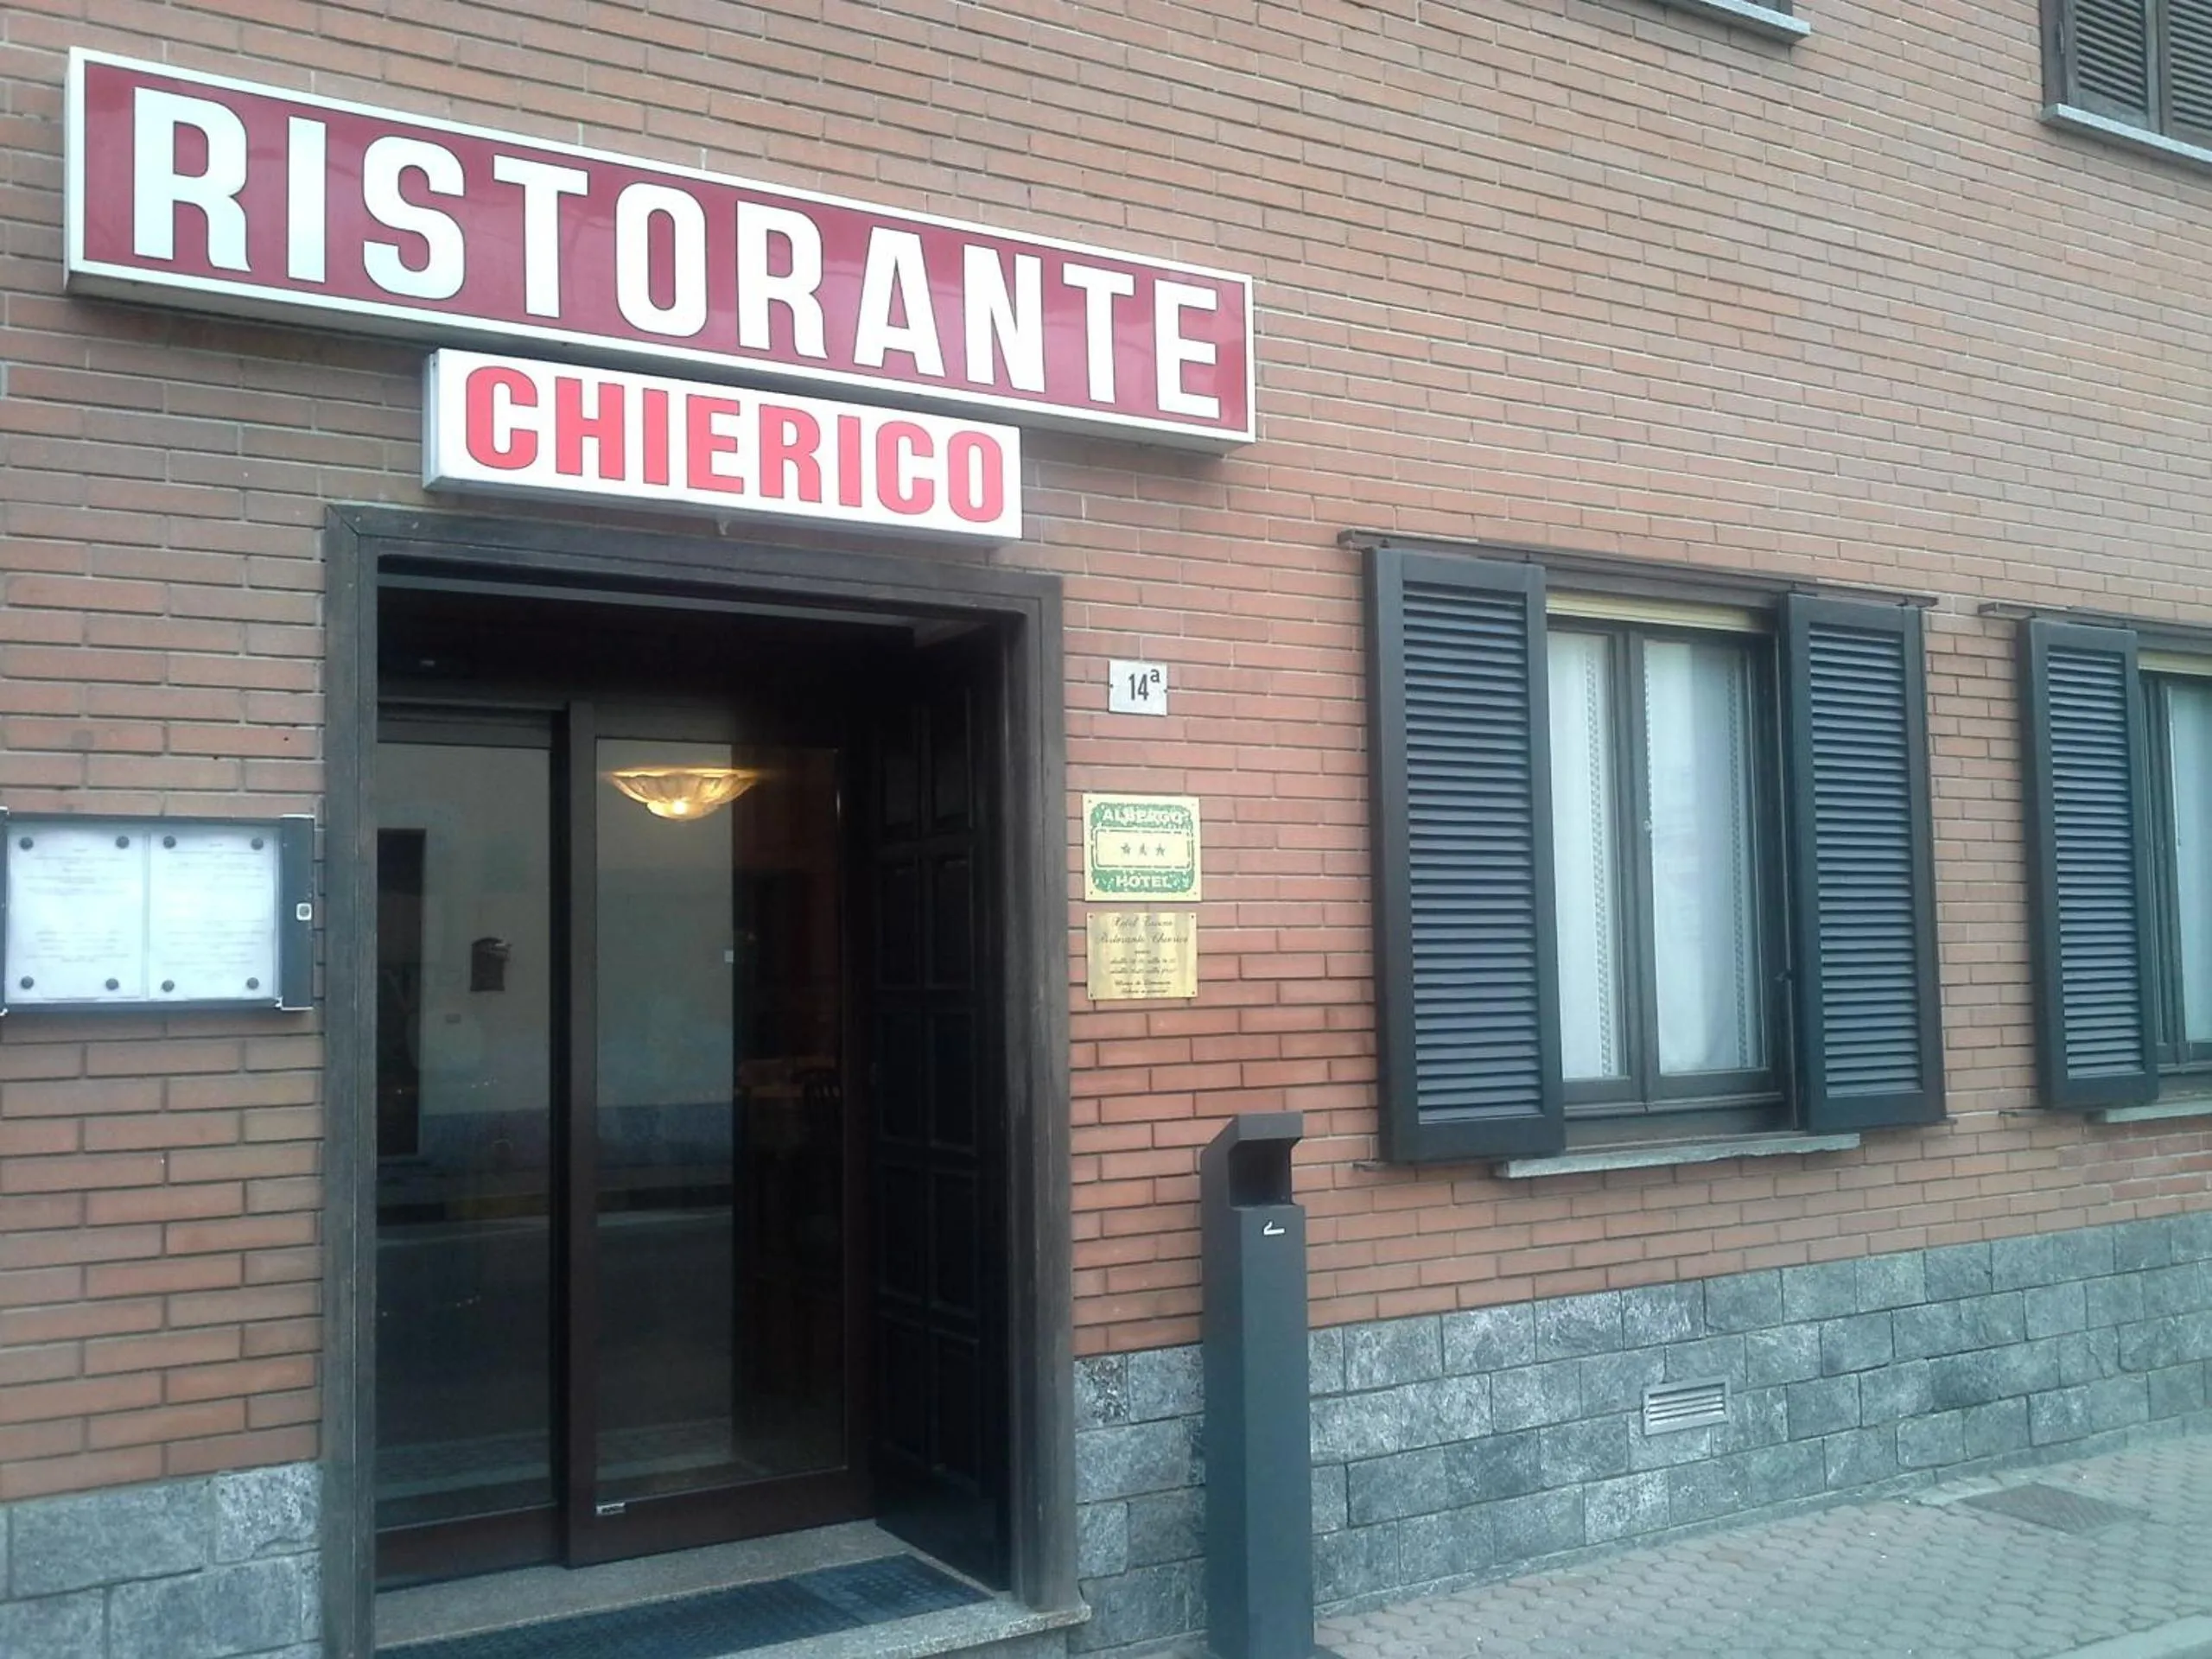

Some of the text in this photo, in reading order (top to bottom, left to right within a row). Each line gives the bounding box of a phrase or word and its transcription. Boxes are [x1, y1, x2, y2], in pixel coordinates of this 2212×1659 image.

[131, 86, 1220, 418] RISTORANTE
[464, 365, 1006, 524] CHIERICO
[1102, 806, 1184, 825] ALBERGO
[1116, 874, 1171, 888] HOTEL
